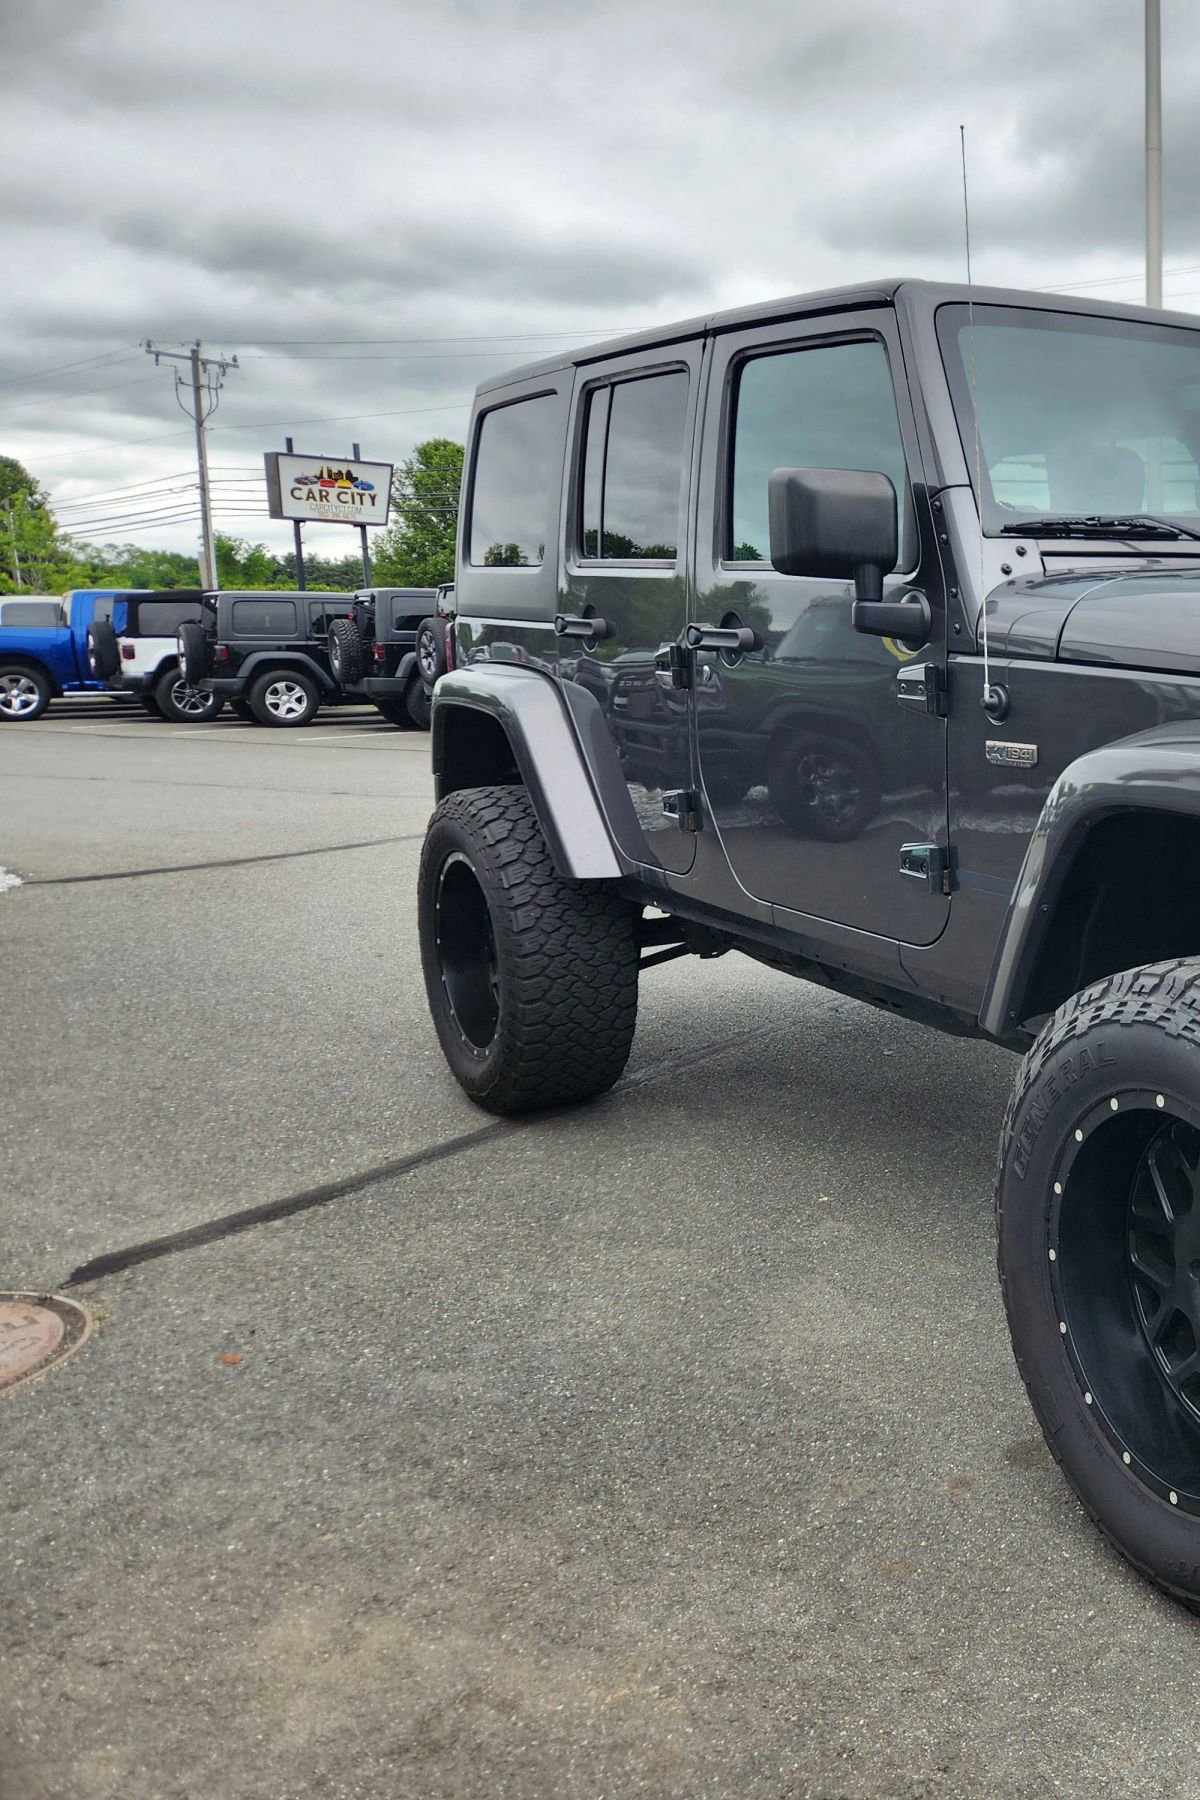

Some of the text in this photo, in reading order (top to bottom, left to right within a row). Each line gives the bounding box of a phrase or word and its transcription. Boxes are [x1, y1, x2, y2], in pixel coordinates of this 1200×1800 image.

[290, 487, 378, 507] CAR CITY
[1013, 1041, 1118, 1180] GENERAL
